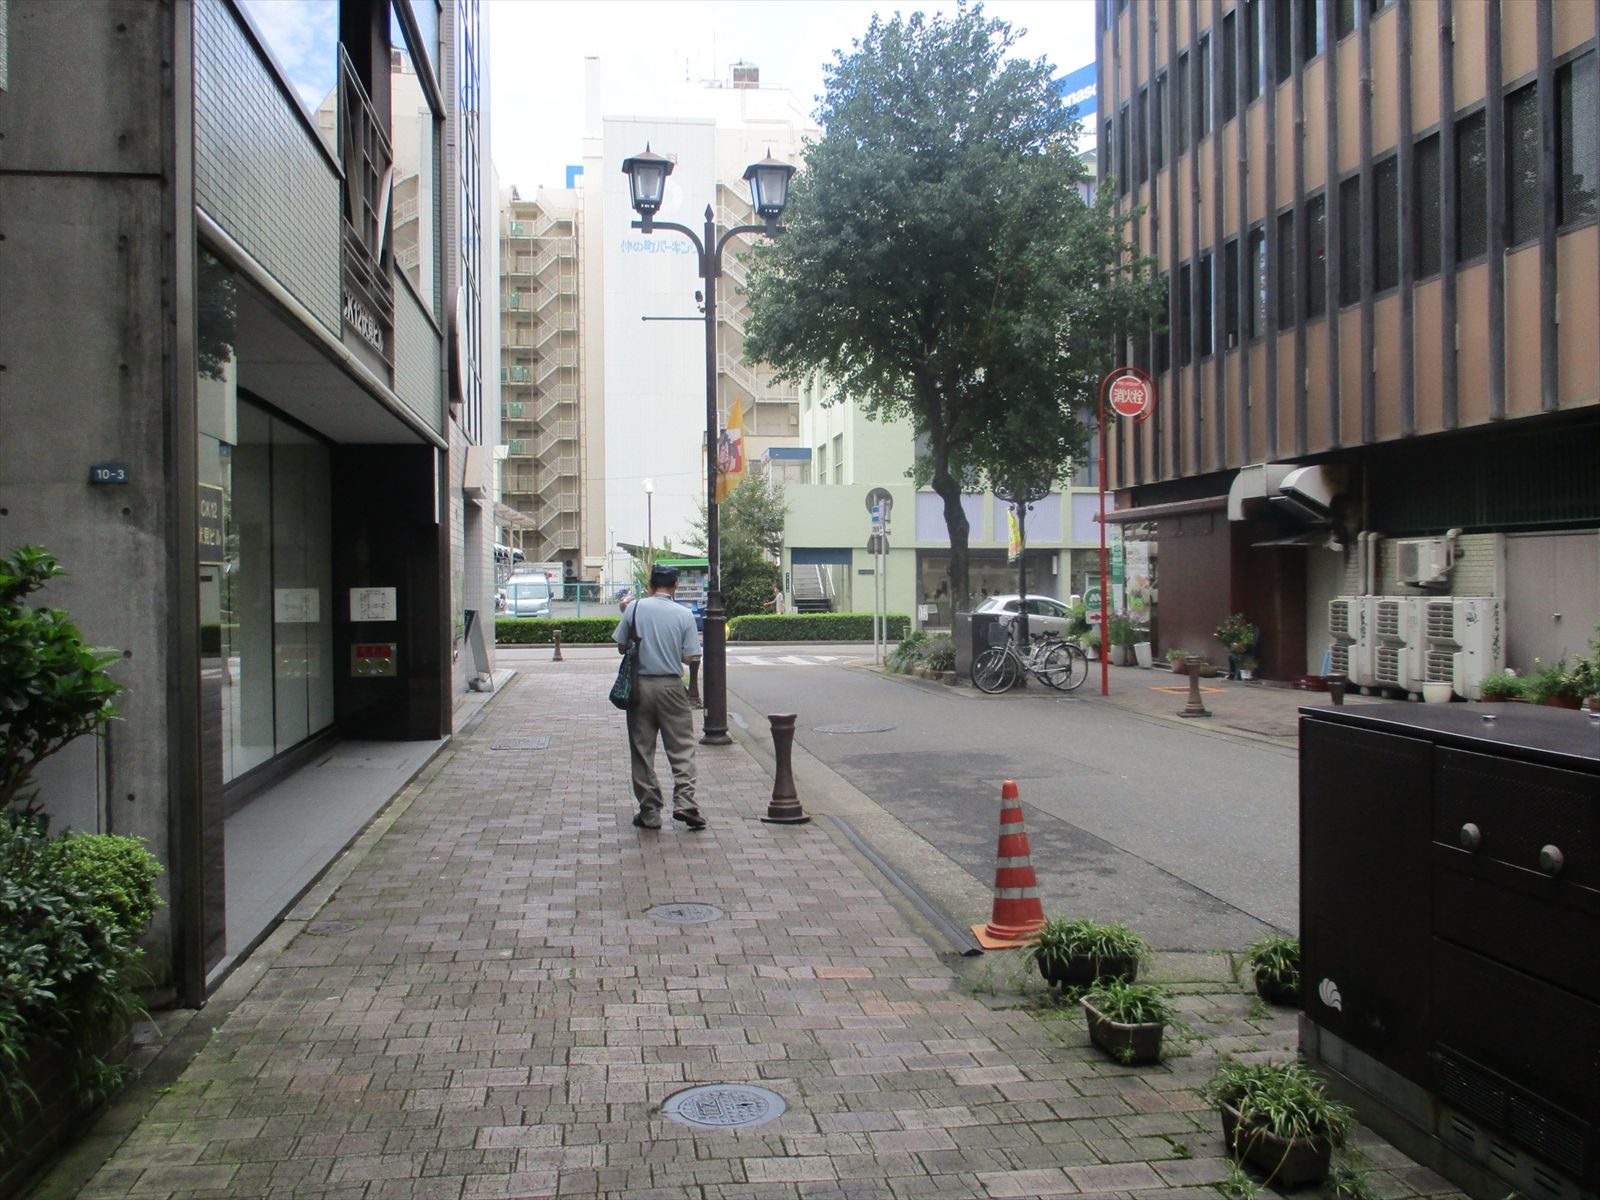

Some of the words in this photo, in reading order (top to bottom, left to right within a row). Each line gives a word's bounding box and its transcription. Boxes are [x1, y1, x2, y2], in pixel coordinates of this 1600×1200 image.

[1060, 82, 1097, 108] anas
[620, 239, 699, 254] 仲の町パーキン
[1113, 388, 1145, 405] 消火栓
[96, 468, 125, 480] 10-3
[200, 499, 218, 519] CK12
